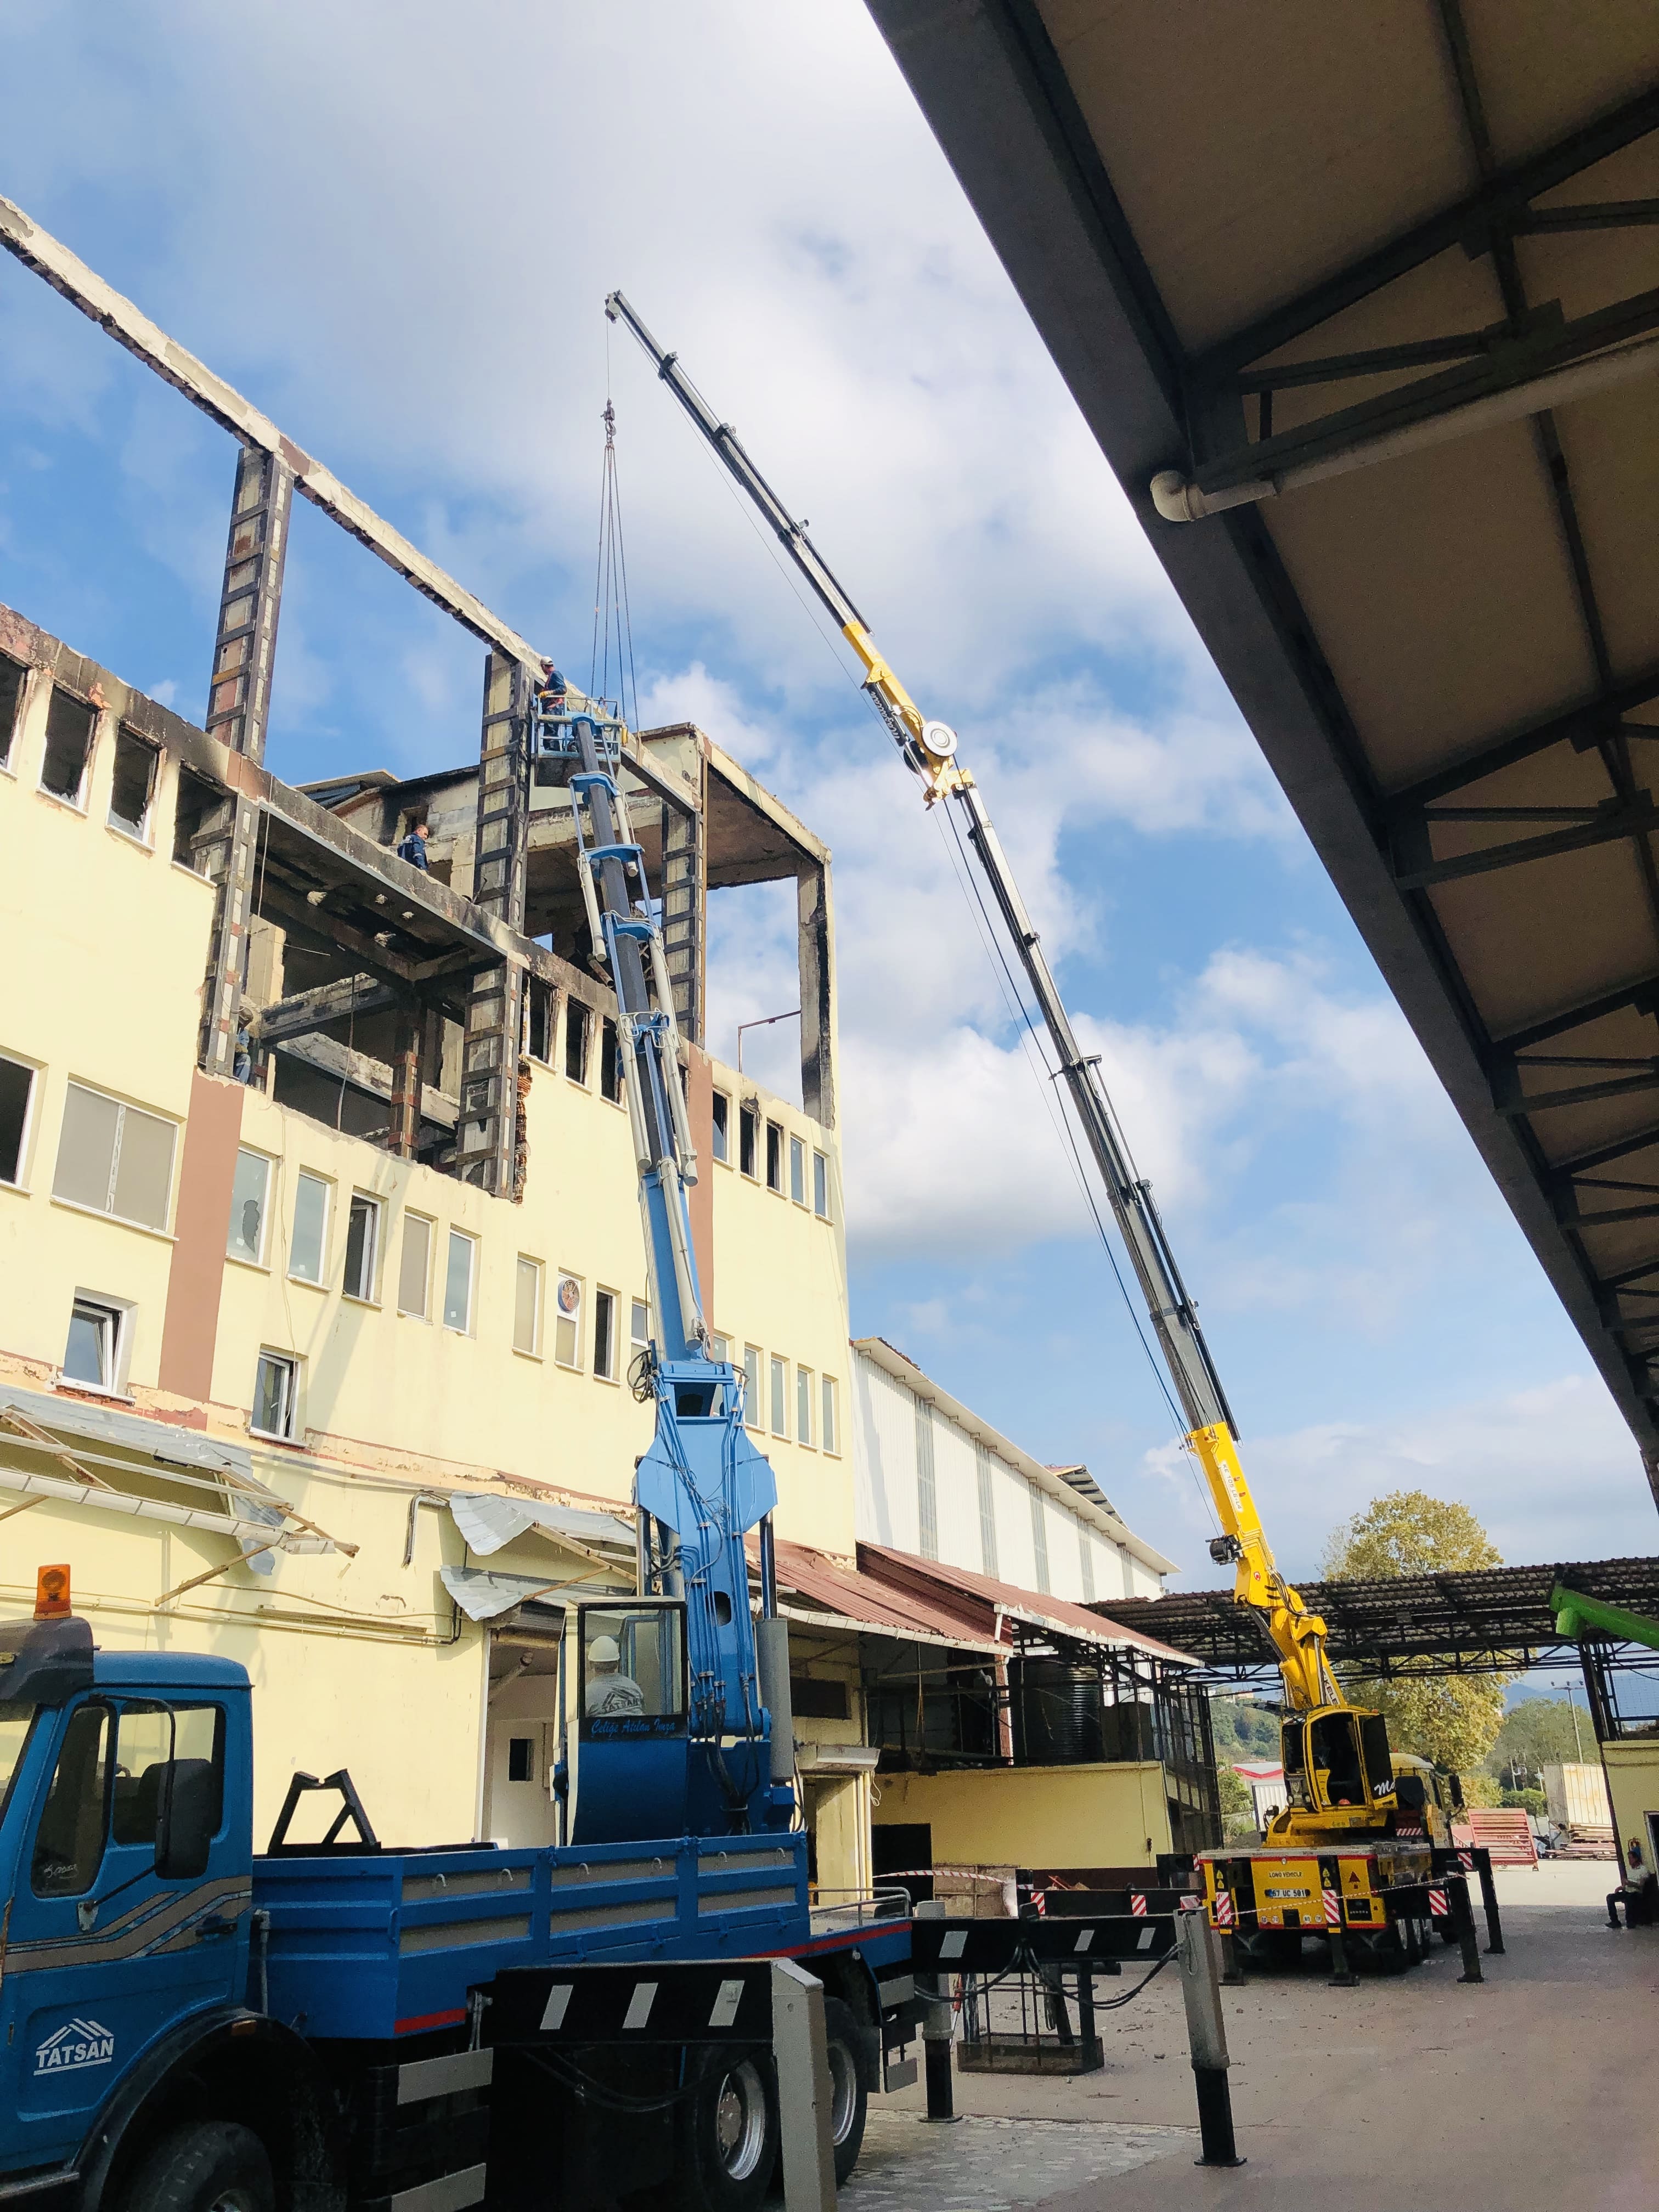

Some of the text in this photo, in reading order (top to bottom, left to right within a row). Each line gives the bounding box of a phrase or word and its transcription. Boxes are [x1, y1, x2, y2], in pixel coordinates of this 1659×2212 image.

[1222, 1464, 1229, 1473] KE
[602, 1698, 639, 1712] TATSAN
[36, 2038, 115, 2068] TATSAN
